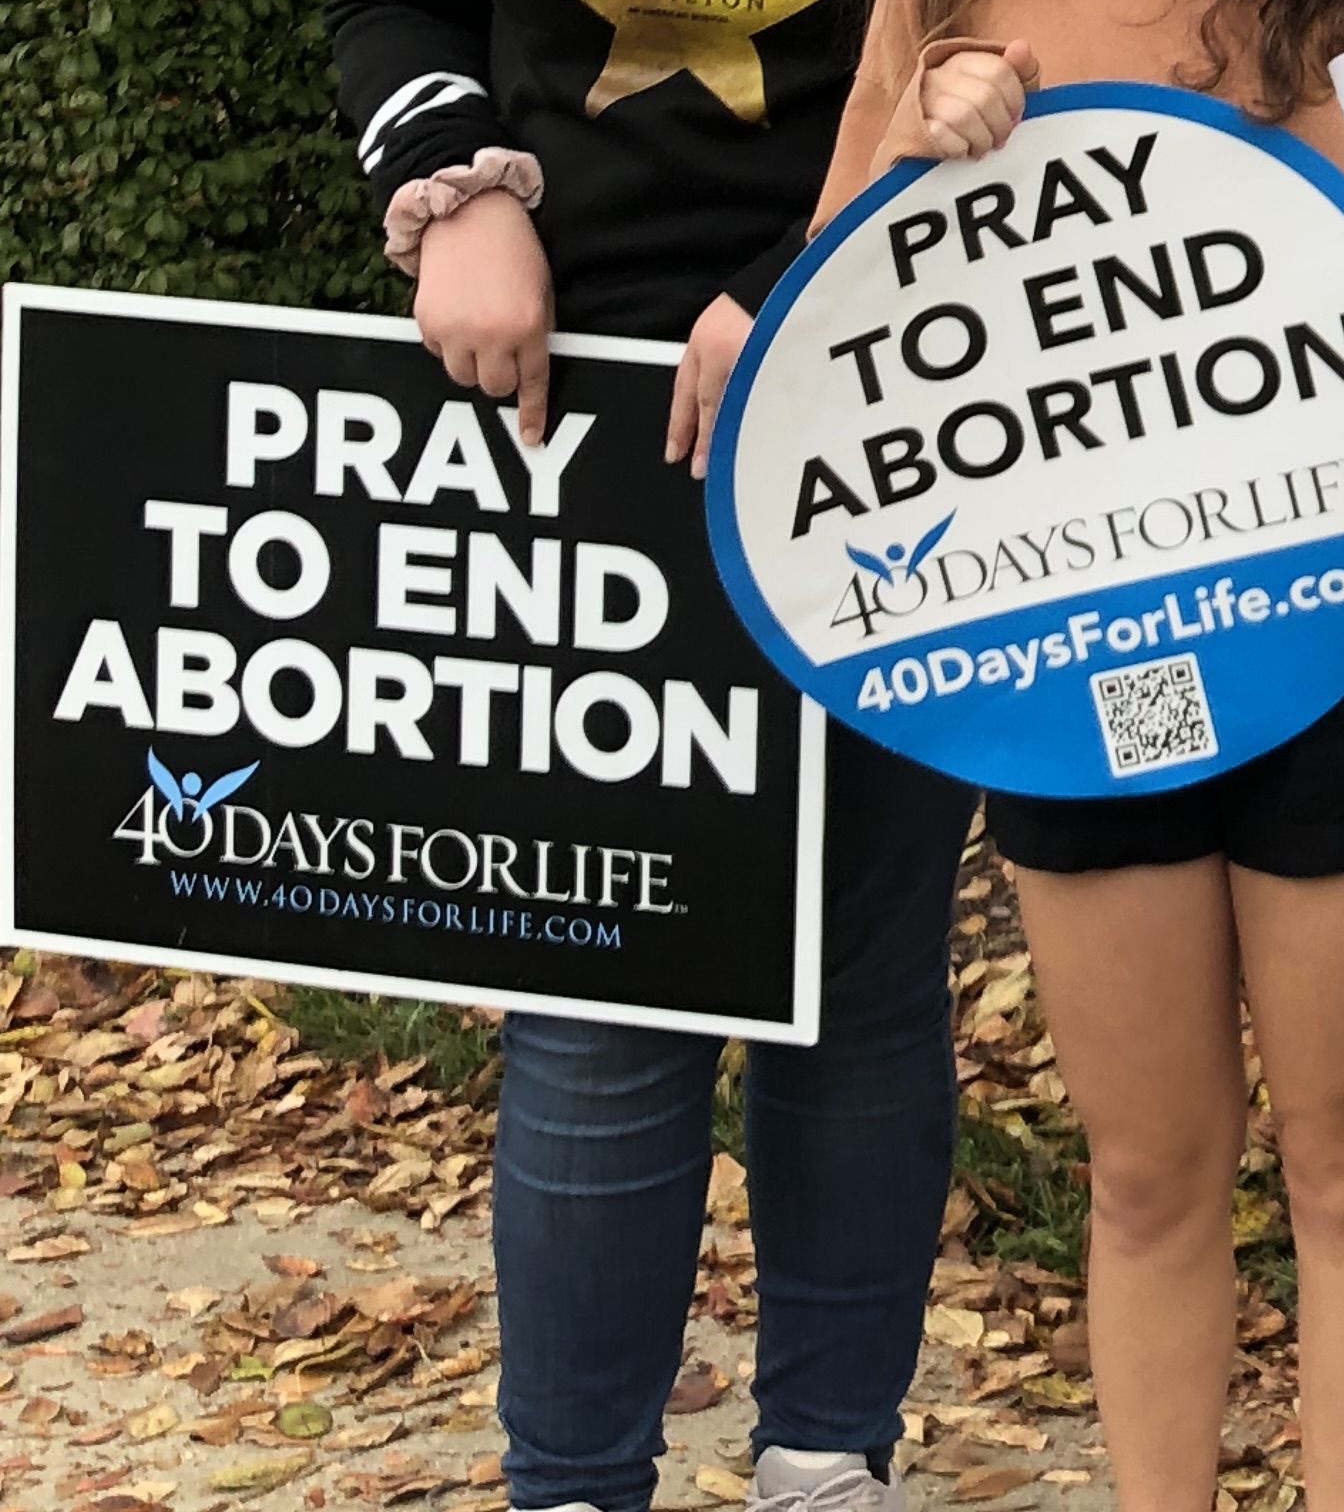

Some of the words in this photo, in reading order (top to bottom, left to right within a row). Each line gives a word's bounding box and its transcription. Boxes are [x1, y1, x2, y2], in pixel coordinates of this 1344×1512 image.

[887, 131, 1160, 289] PRAY
[829, 302, 988, 406] TO
[1024, 229, 1265, 351] END
[226, 380, 597, 518] PRAY
[145, 500, 330, 620] TO
[377, 522, 669, 652] END
[53, 619, 759, 796] ABORTION
